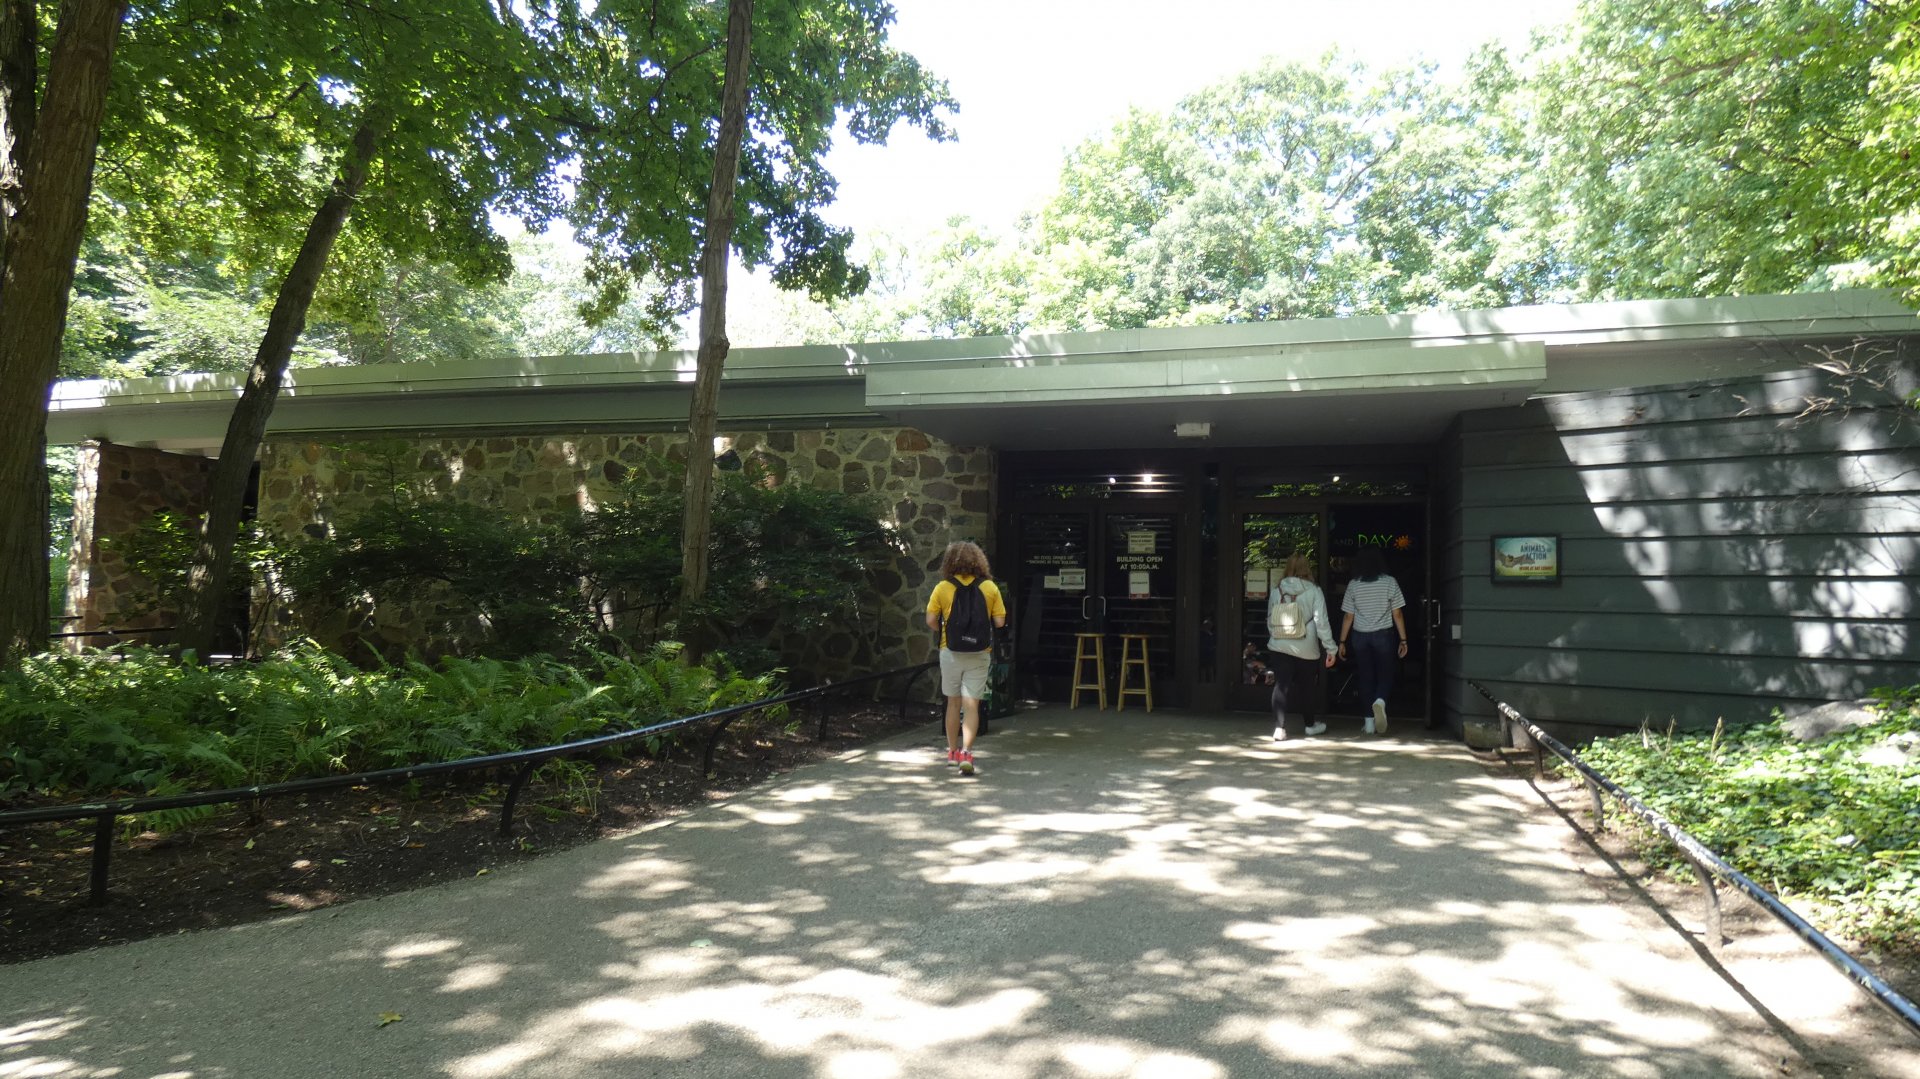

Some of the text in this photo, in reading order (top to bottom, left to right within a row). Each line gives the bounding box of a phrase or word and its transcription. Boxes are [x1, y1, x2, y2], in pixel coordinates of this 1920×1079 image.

[1358, 534, 1393, 548] DAY
[1520, 544, 1546, 552] ANIMALS
[1526, 552, 1547, 560] ACTION
